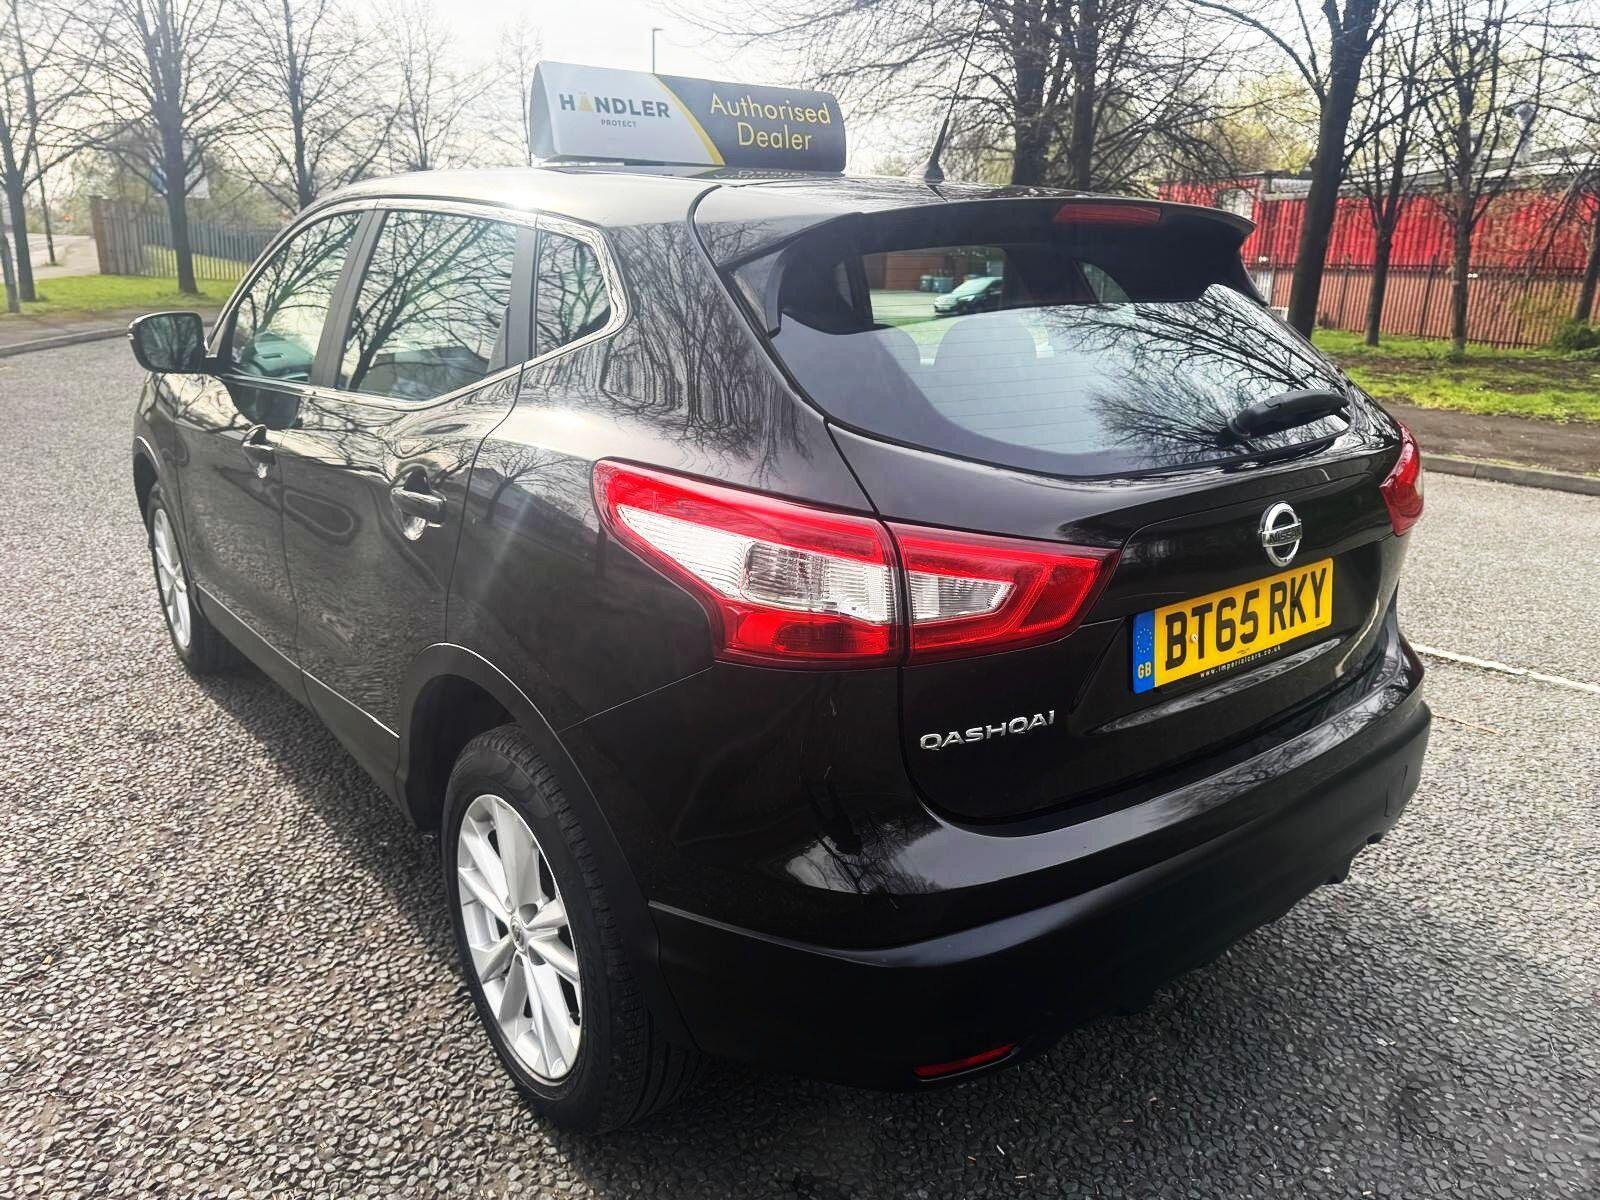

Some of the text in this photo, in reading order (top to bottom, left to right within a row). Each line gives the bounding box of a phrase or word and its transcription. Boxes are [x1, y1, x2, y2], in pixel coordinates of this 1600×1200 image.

[601, 119, 637, 128] PROTECT
[710, 92, 831, 125] Authorised
[737, 122, 812, 150] Dealer
[1165, 568, 1327, 672] BT65 RKY
[1138, 662, 1152, 679] GB
[920, 709, 1055, 751] QASHQAI
